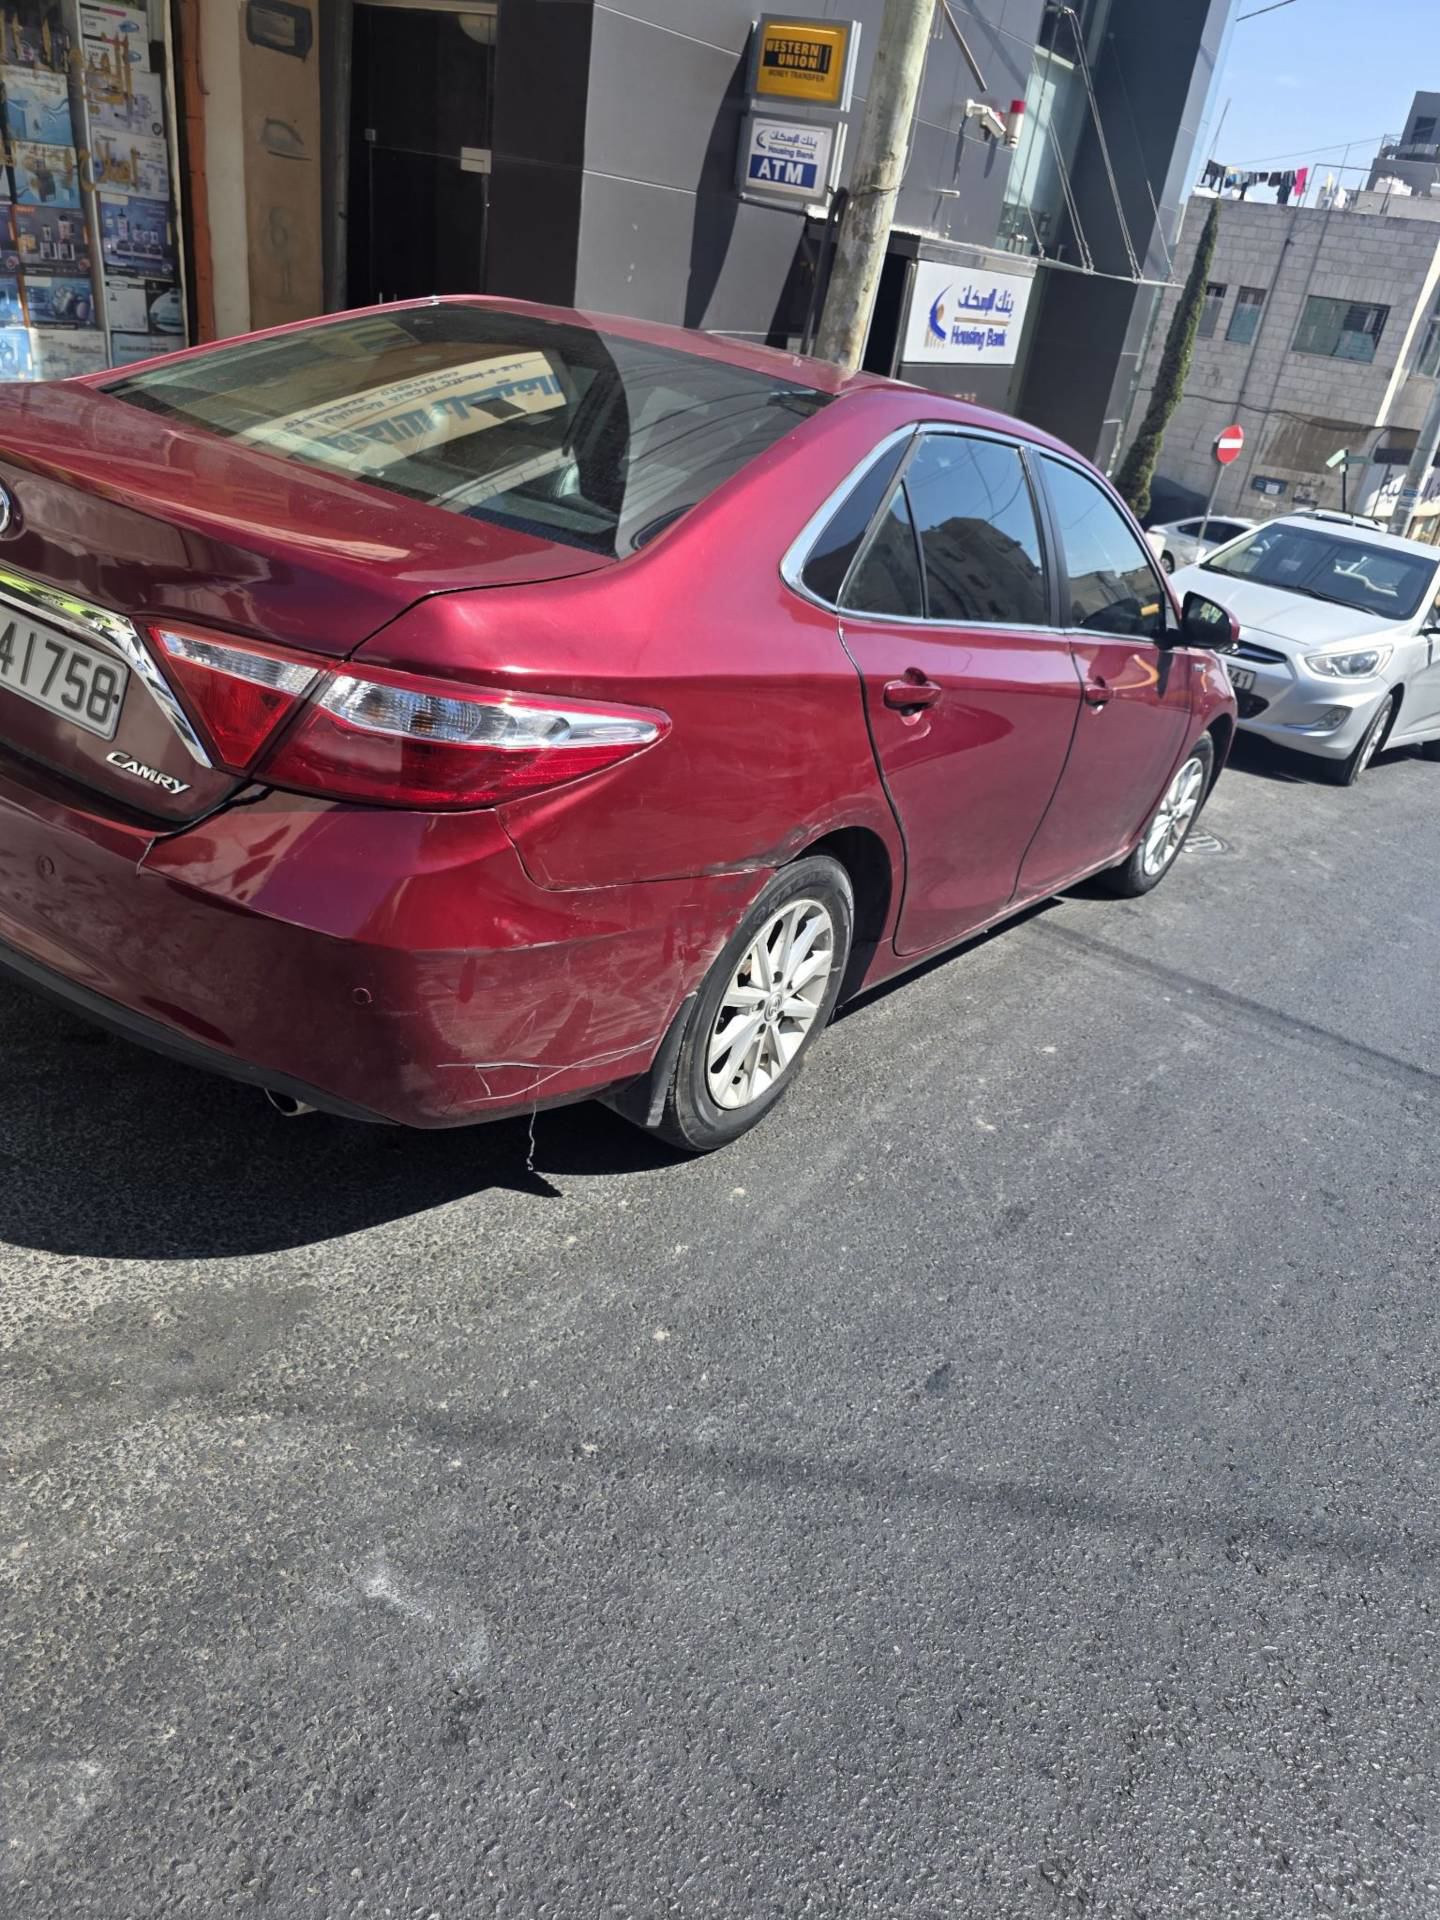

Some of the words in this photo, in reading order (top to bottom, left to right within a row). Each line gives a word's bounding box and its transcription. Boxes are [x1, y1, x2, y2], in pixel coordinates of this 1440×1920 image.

[766, 40, 819, 56] WESTERN
[778, 53, 817, 70] UNION
[787, 71, 825, 83] TRANSFER
[801, 134, 817, 149] بنك
[768, 145, 795, 159] Housing
[796, 149, 814, 161] Bank
[757, 158, 804, 185] ATM
[995, 289, 1015, 319] بنك
[951, 325, 986, 352] Housing
[986, 328, 1007, 347] Bank
[105, 750, 192, 795] CAMRY
